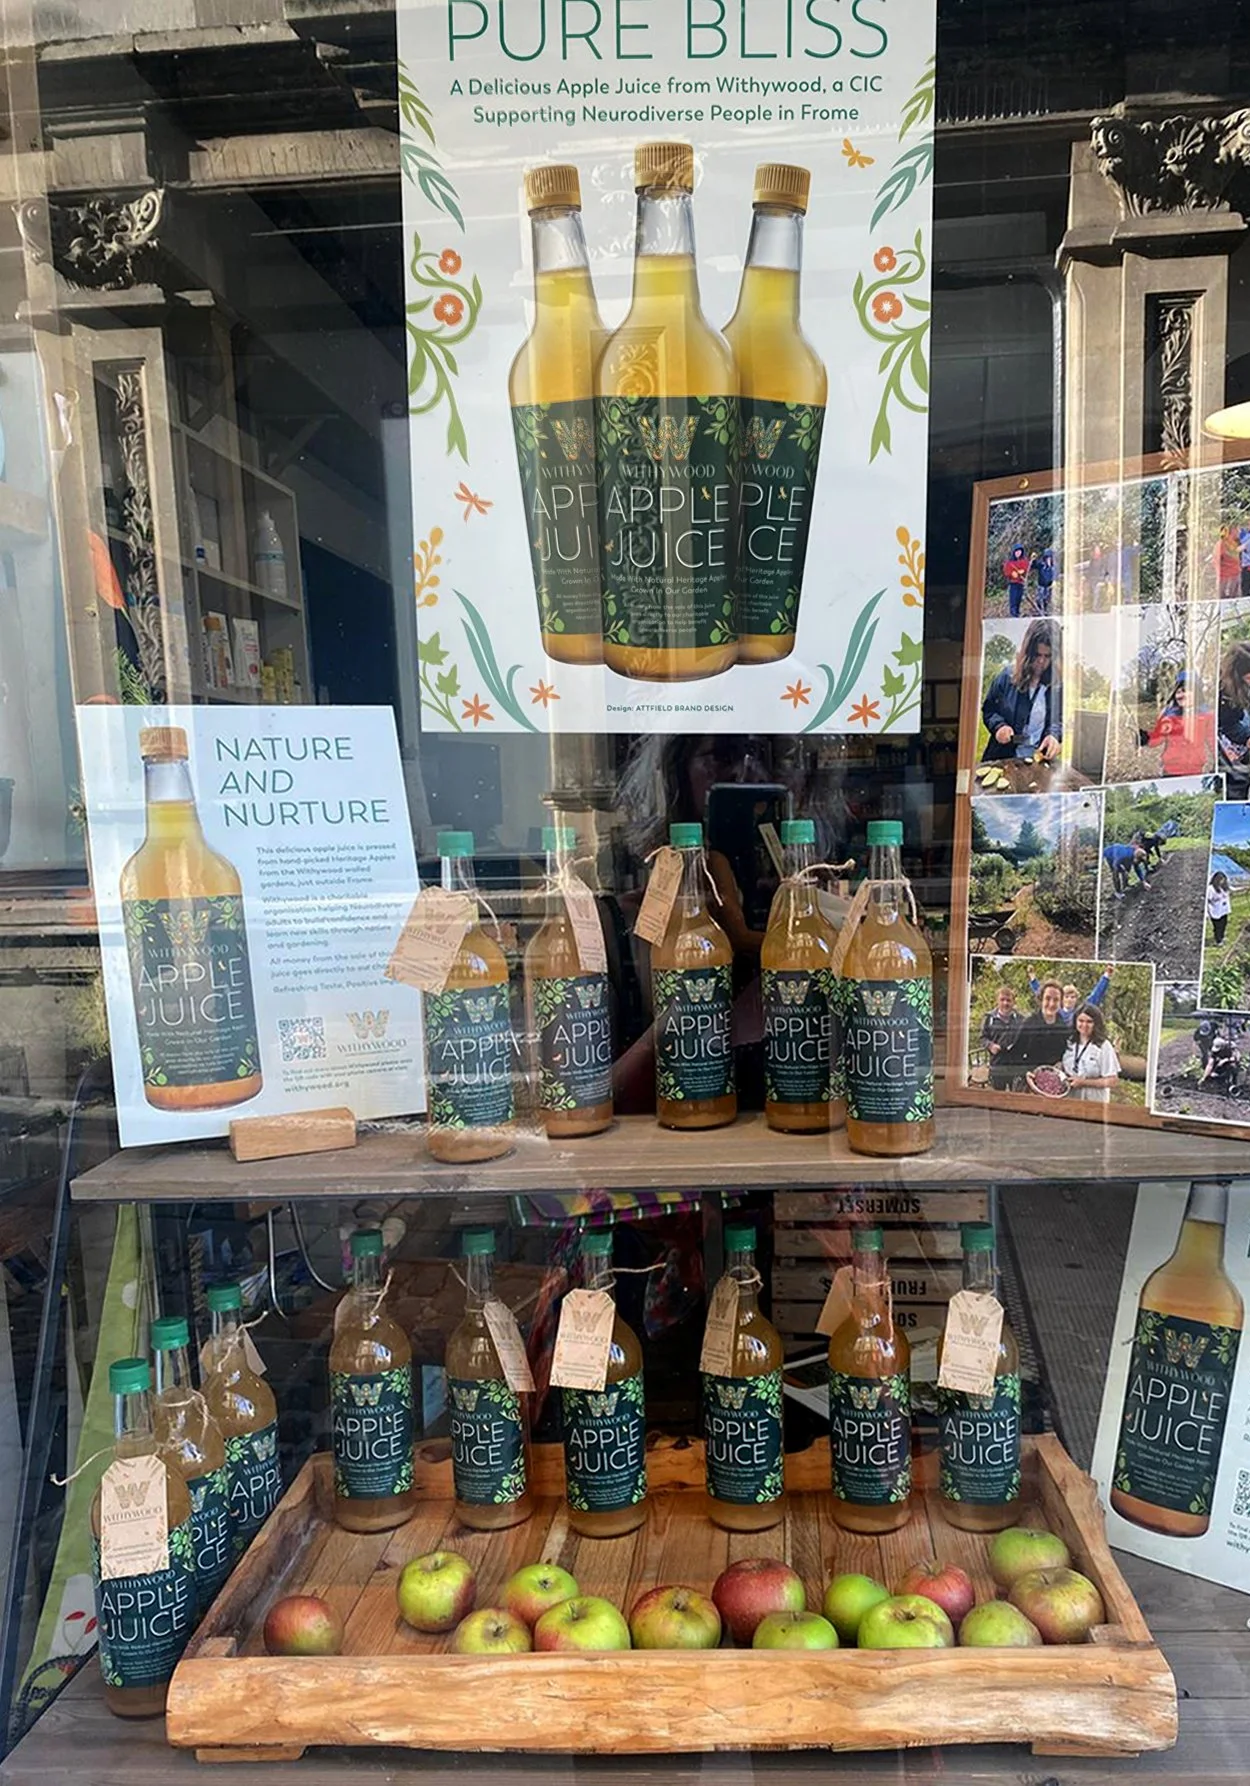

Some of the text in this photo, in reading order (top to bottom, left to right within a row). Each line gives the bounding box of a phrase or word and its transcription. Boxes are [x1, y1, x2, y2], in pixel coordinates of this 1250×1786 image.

[448, 0, 888, 61] PURE BLISS
[450, 76, 882, 99] A Delicious Apple Juice from Withywood, a CIC
[474, 105, 859, 127] Supporting Neurodiverse People in Frome
[623, 464, 715, 478] WITHYWOOD
[532, 483, 600, 521] APP
[606, 484, 730, 524] APPLE
[611, 529, 725, 568] JUICE
[631, 586, 654, 594] Grown
[645, 576, 673, 584] Natural
[676, 575, 707, 584] Heritage
[215, 737, 354, 761] NATURE
[219, 770, 294, 794] AND
[224, 800, 389, 827] NURTURE
[138, 957, 245, 993] APPLE
[146, 990, 244, 1027] JUICE
[665, 1010, 731, 1036] APPLE
[764, 1014, 832, 1038] APPLE
[669, 1035, 731, 1060] JUICE
[768, 1040, 830, 1062] JUICE
[847, 1028, 919, 1053] APPLE
[449, 1054, 511, 1086] JUICE
[849, 1054, 916, 1078] JUICE
[285, 1081, 349, 1092] withywood.org
[837, 1197, 921, 1214] SOMERSET
[1129, 1374, 1224, 1422] APPLE
[334, 1410, 404, 1437] APPLE
[452, 1421, 505, 1444] PPLE
[570, 1419, 640, 1449] APPLE
[705, 1415, 769, 1442] APPLE
[833, 1417, 902, 1443] APPLE
[945, 1416, 1016, 1443] APPLE
[1127, 1407, 1214, 1455] JUICE
[338, 1433, 402, 1461] JUICE
[575, 1442, 639, 1472] JUICE
[708, 1441, 767, 1465] JUICE
[836, 1443, 899, 1465] JUICE
[950, 1440, 1014, 1465] JUICE
[103, 1507, 162, 1522] WITHYWOOD
[101, 1575, 188, 1615] APPLE
[107, 1603, 186, 1642] JUICE
